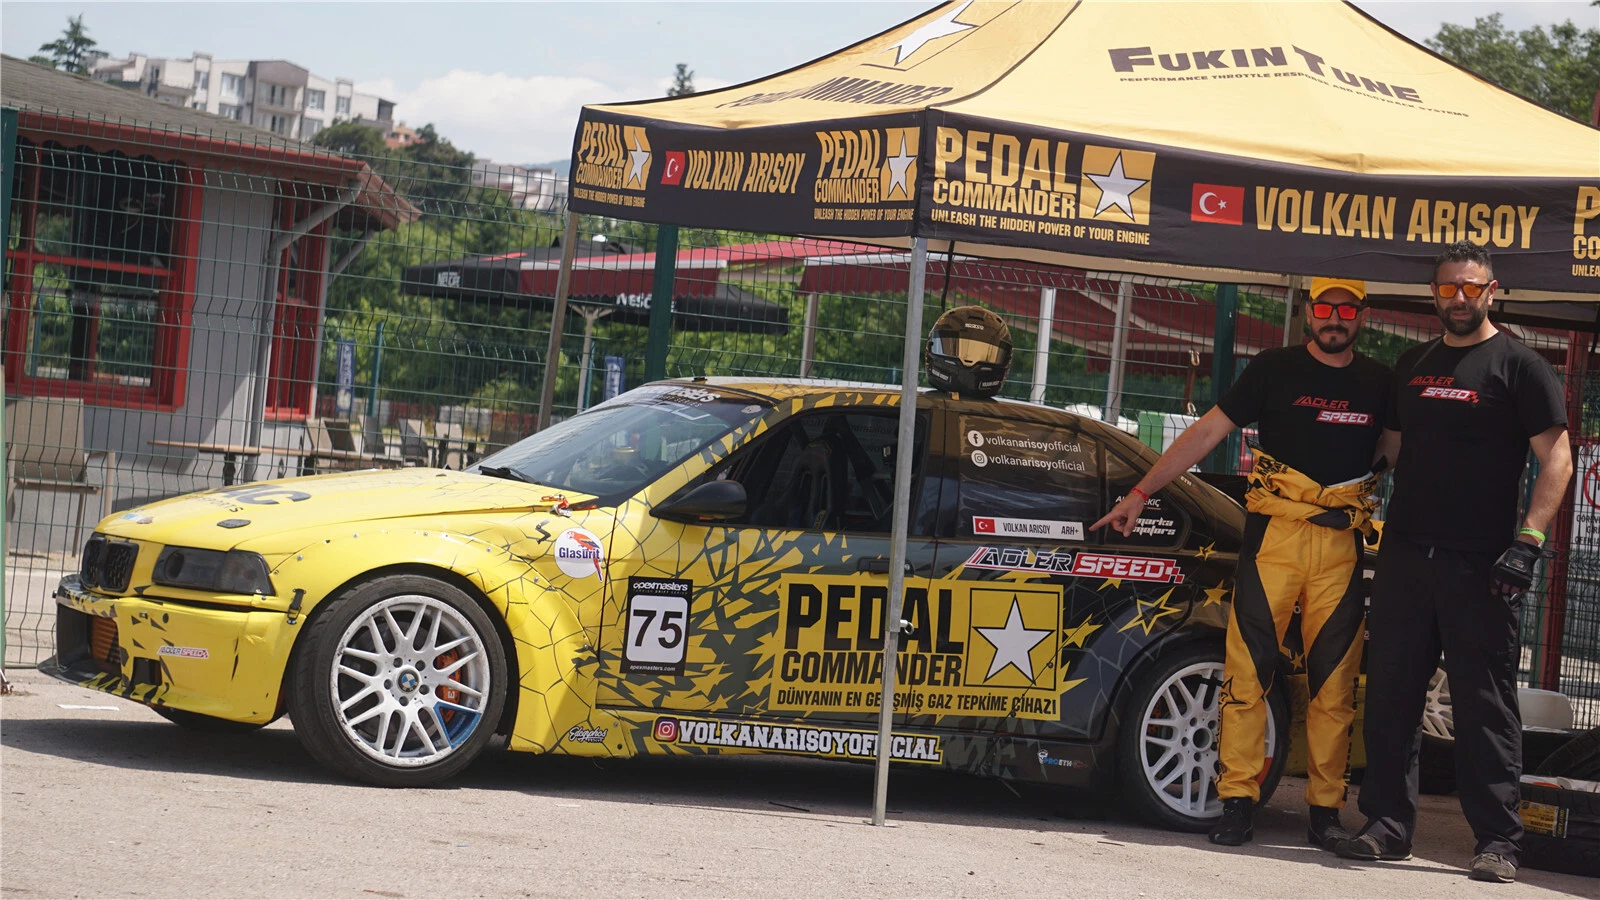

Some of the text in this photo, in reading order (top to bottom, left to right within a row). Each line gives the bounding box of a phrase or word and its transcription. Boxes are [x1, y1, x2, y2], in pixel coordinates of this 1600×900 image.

[1108, 44, 1423, 104] FUKIN TUNE
[1274, 71, 1330, 86] RESPONSE
[577, 121, 627, 168] PEDAL
[815, 129, 881, 179] PEDAL
[684, 150, 806, 194] VOLKAN ARISOY
[934, 126, 1077, 193] PEDAL
[575, 162, 623, 190] COMMANDER
[814, 178, 880, 203] COMMANDER
[932, 178, 1076, 219] COMMANDER
[931, 208, 1150, 245] UNLEASH THE HIDDEN POWER OF YOUR ENGINE
[1255, 185, 1540, 250] VOLKAN ARISOY
[1411, 375, 1455, 385] ADLER
[1300, 396, 1349, 409] ADLER
[1421, 387, 1471, 399] SPEED
[1319, 410, 1369, 424] SPEED
[985, 436, 1081, 453] volkanarisoyofficial
[989, 454, 1086, 471] volkanarisoyofficial
[1003, 522, 1079, 535] VOLKAN ARISOY ARH+
[558, 547, 600, 559] Glasurit
[976, 547, 1073, 573] ADLER
[1076, 555, 1166, 579] SPEED
[633, 581, 688, 591] apexmasters
[633, 609, 683, 649] 75
[784, 583, 965, 654] PEDAL
[181, 647, 204, 658] SPEED
[630, 664, 676, 672] apexmasters.com
[777, 687, 843, 706] DÜNYANIN
[845, 691, 860, 706] EN
[864, 691, 924, 712] GEŞMİŞ
[927, 693, 952, 710] GAZ
[957, 692, 1008, 711] TEPKİME
[679, 719, 941, 760] VOLKANARISOYOFCIAL
